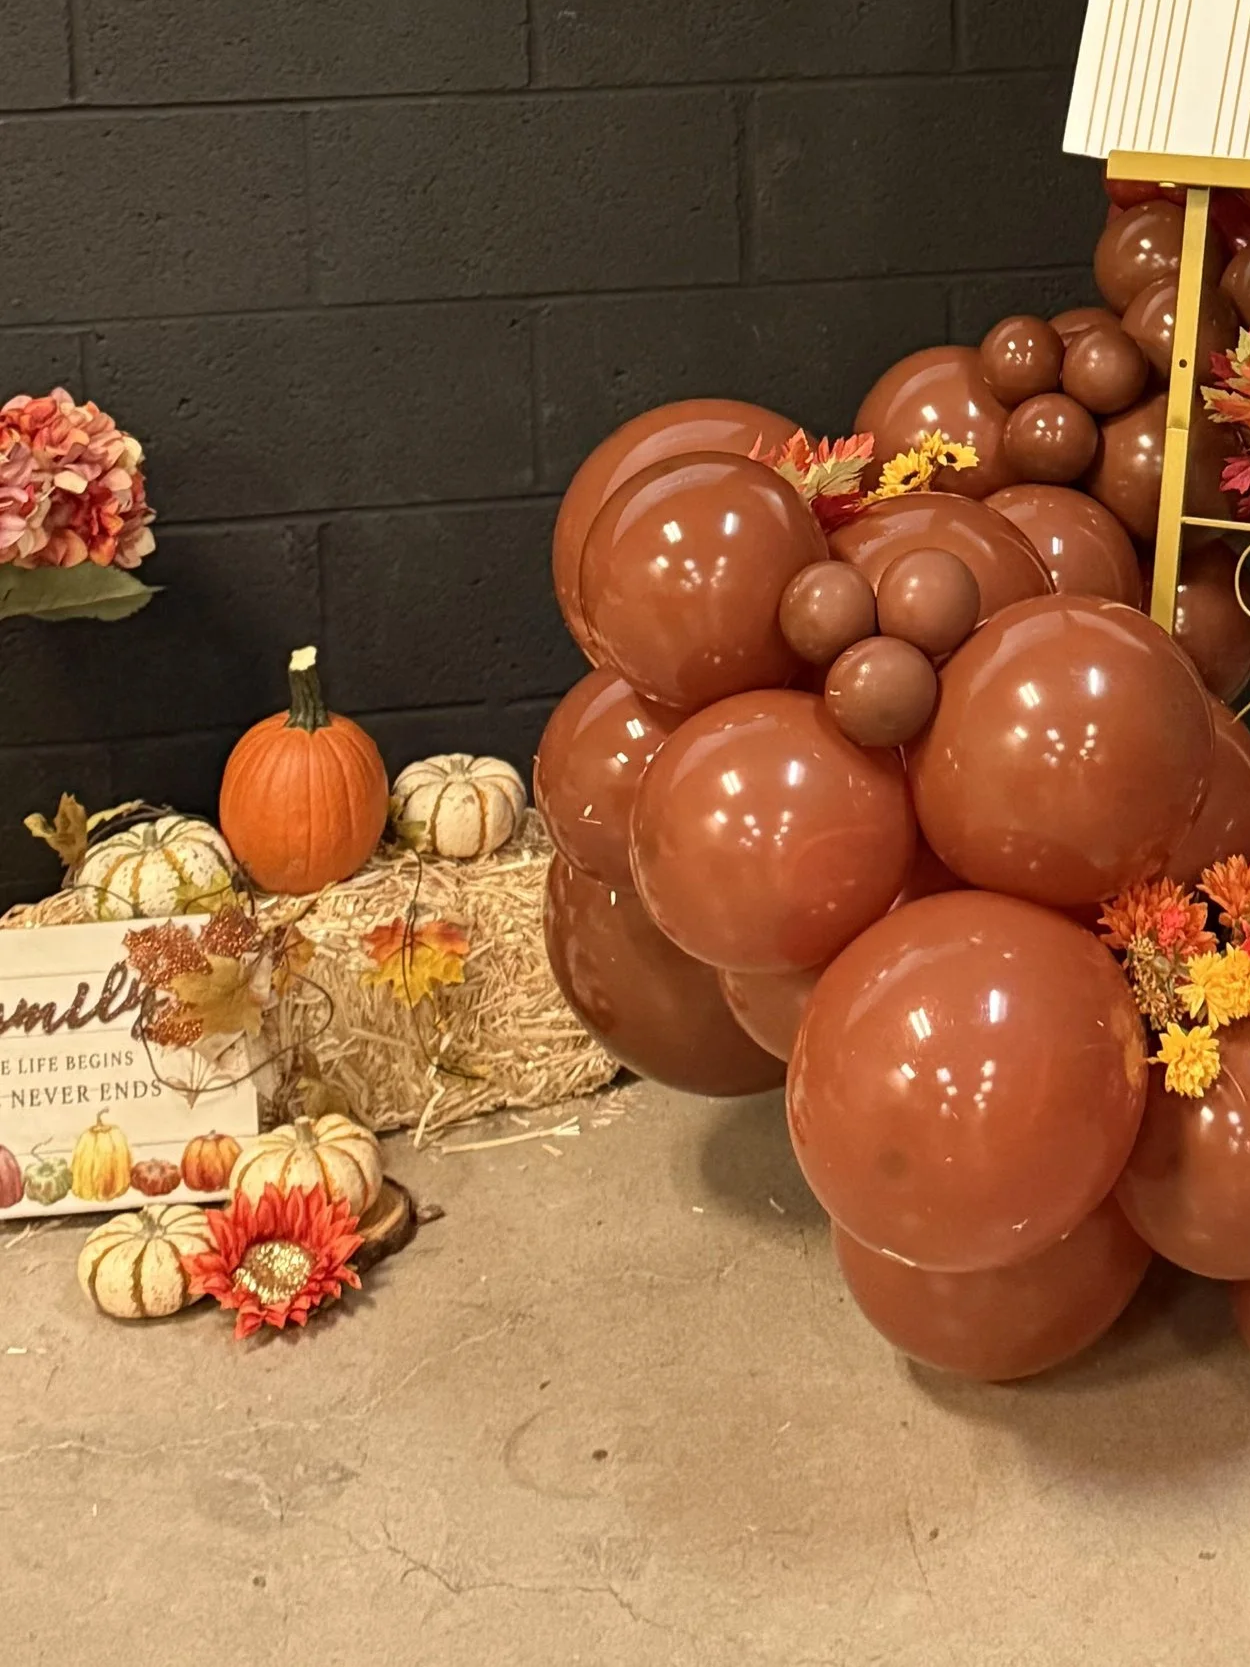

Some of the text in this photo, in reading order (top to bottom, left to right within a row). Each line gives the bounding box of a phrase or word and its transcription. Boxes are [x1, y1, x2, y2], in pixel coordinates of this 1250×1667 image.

[0, 959, 171, 1043] mily
[18, 1056, 59, 1075] LIFE
[65, 1050, 134, 1071] BEGINS
[11, 1079, 163, 1109] NEVER ENDS
